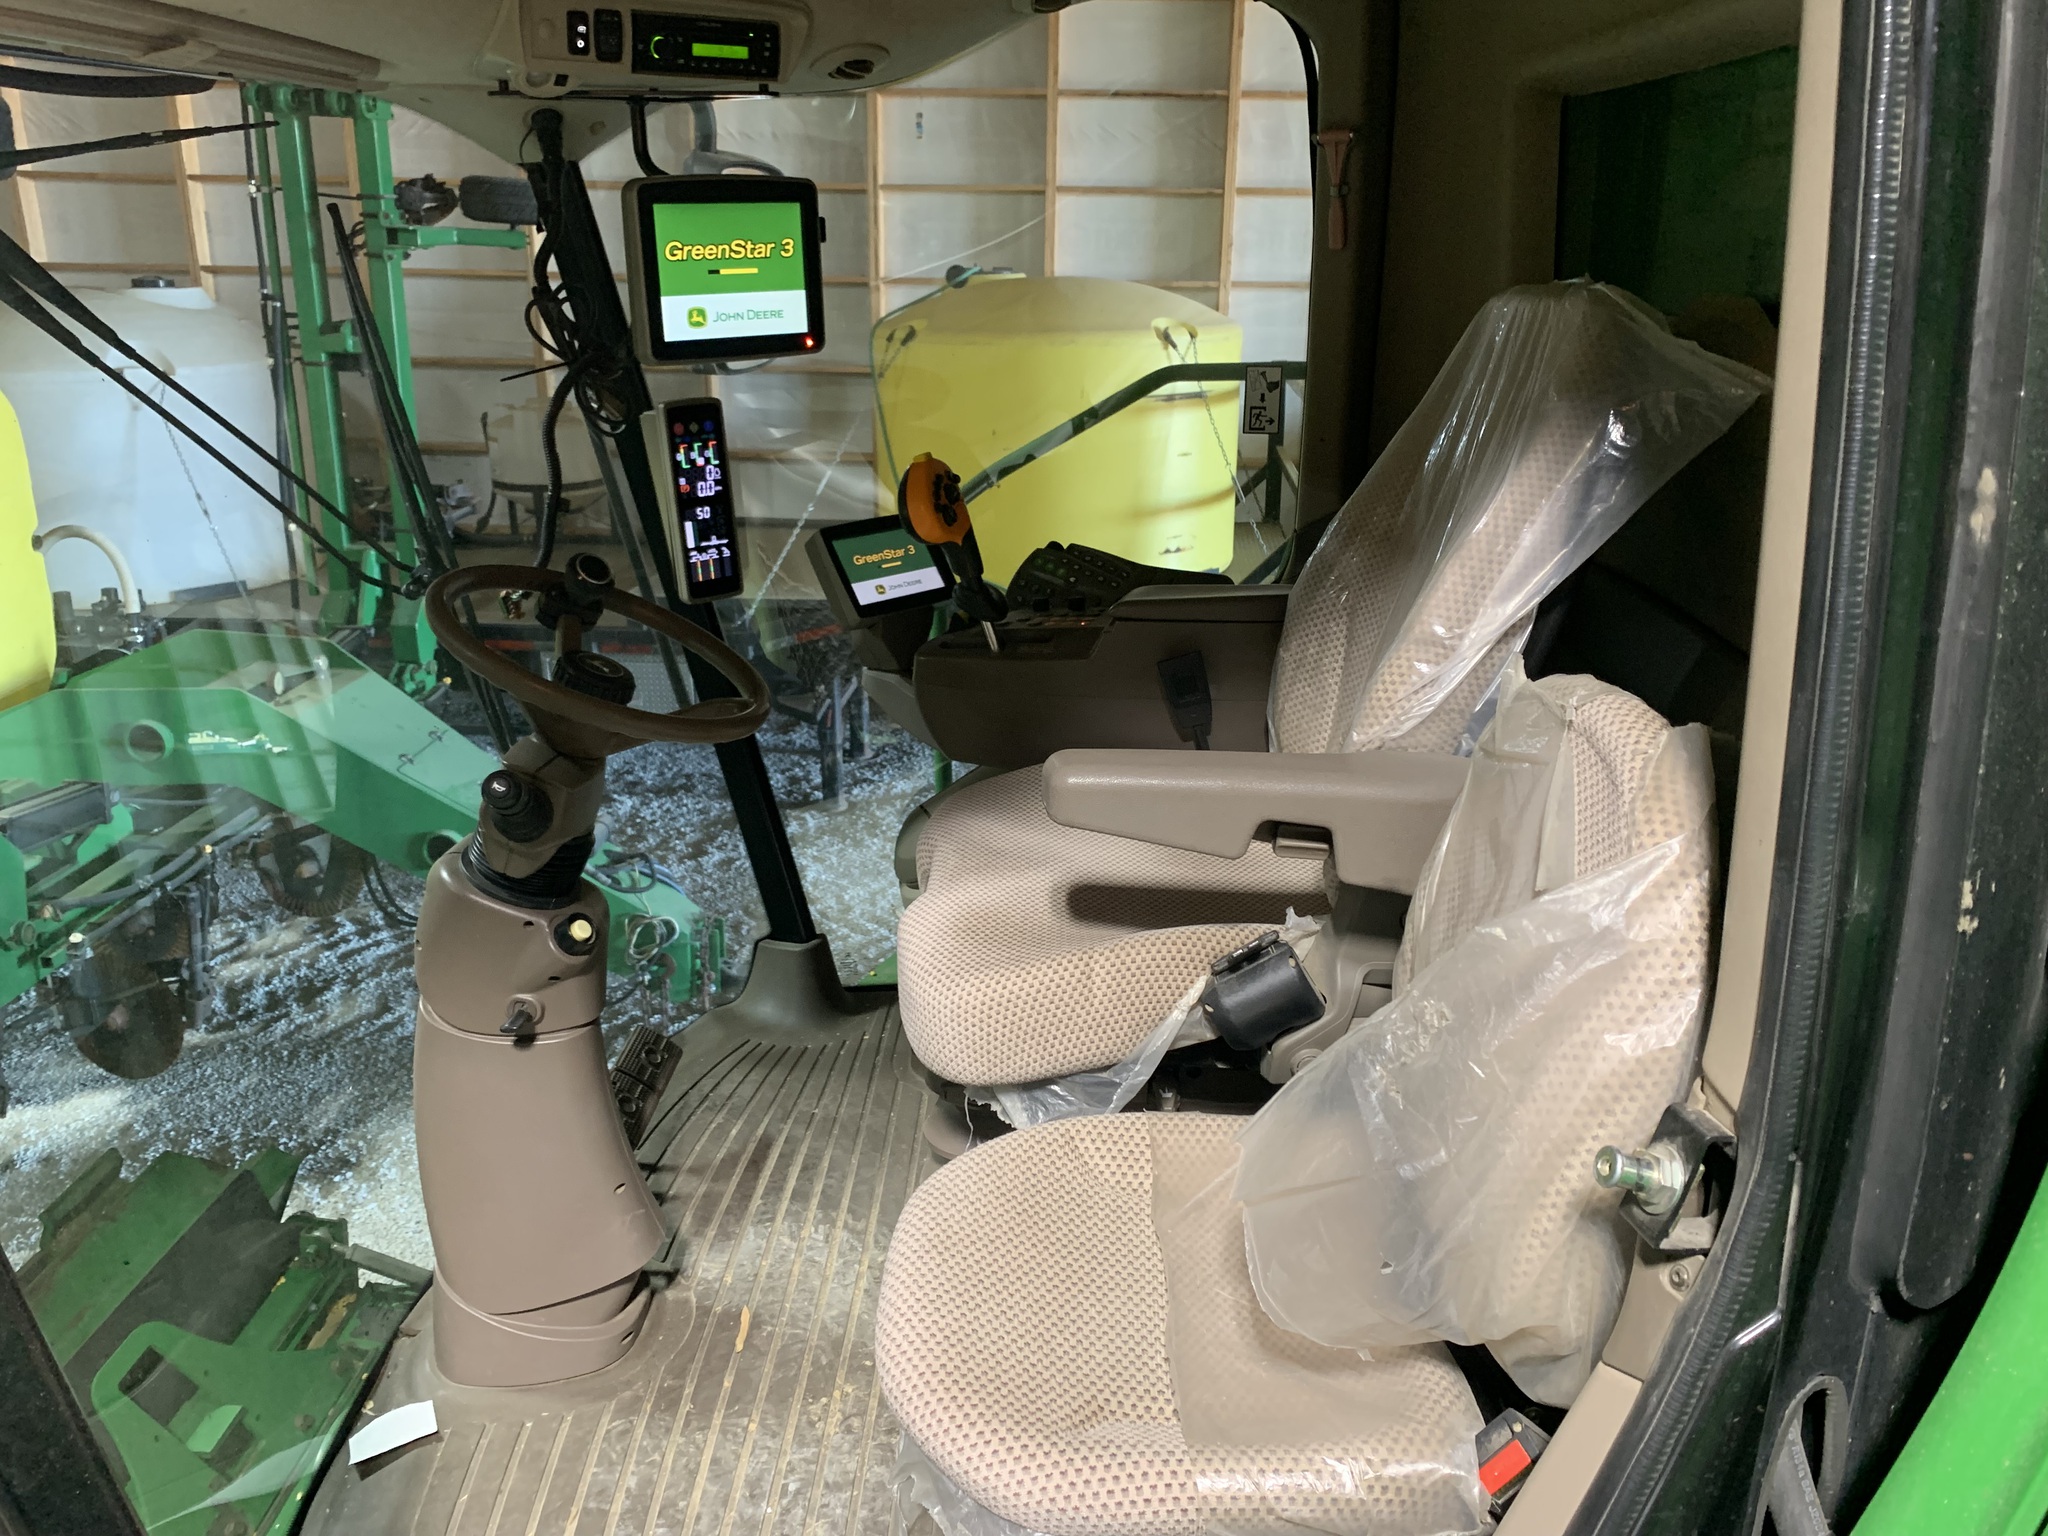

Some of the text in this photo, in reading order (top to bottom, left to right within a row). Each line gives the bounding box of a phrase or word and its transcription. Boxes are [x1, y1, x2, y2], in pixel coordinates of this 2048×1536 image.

[664, 237, 796, 262] GreenStar 3
[713, 309, 784, 323] JOHN DEERE
[853, 544, 916, 566] GreenStar 3
